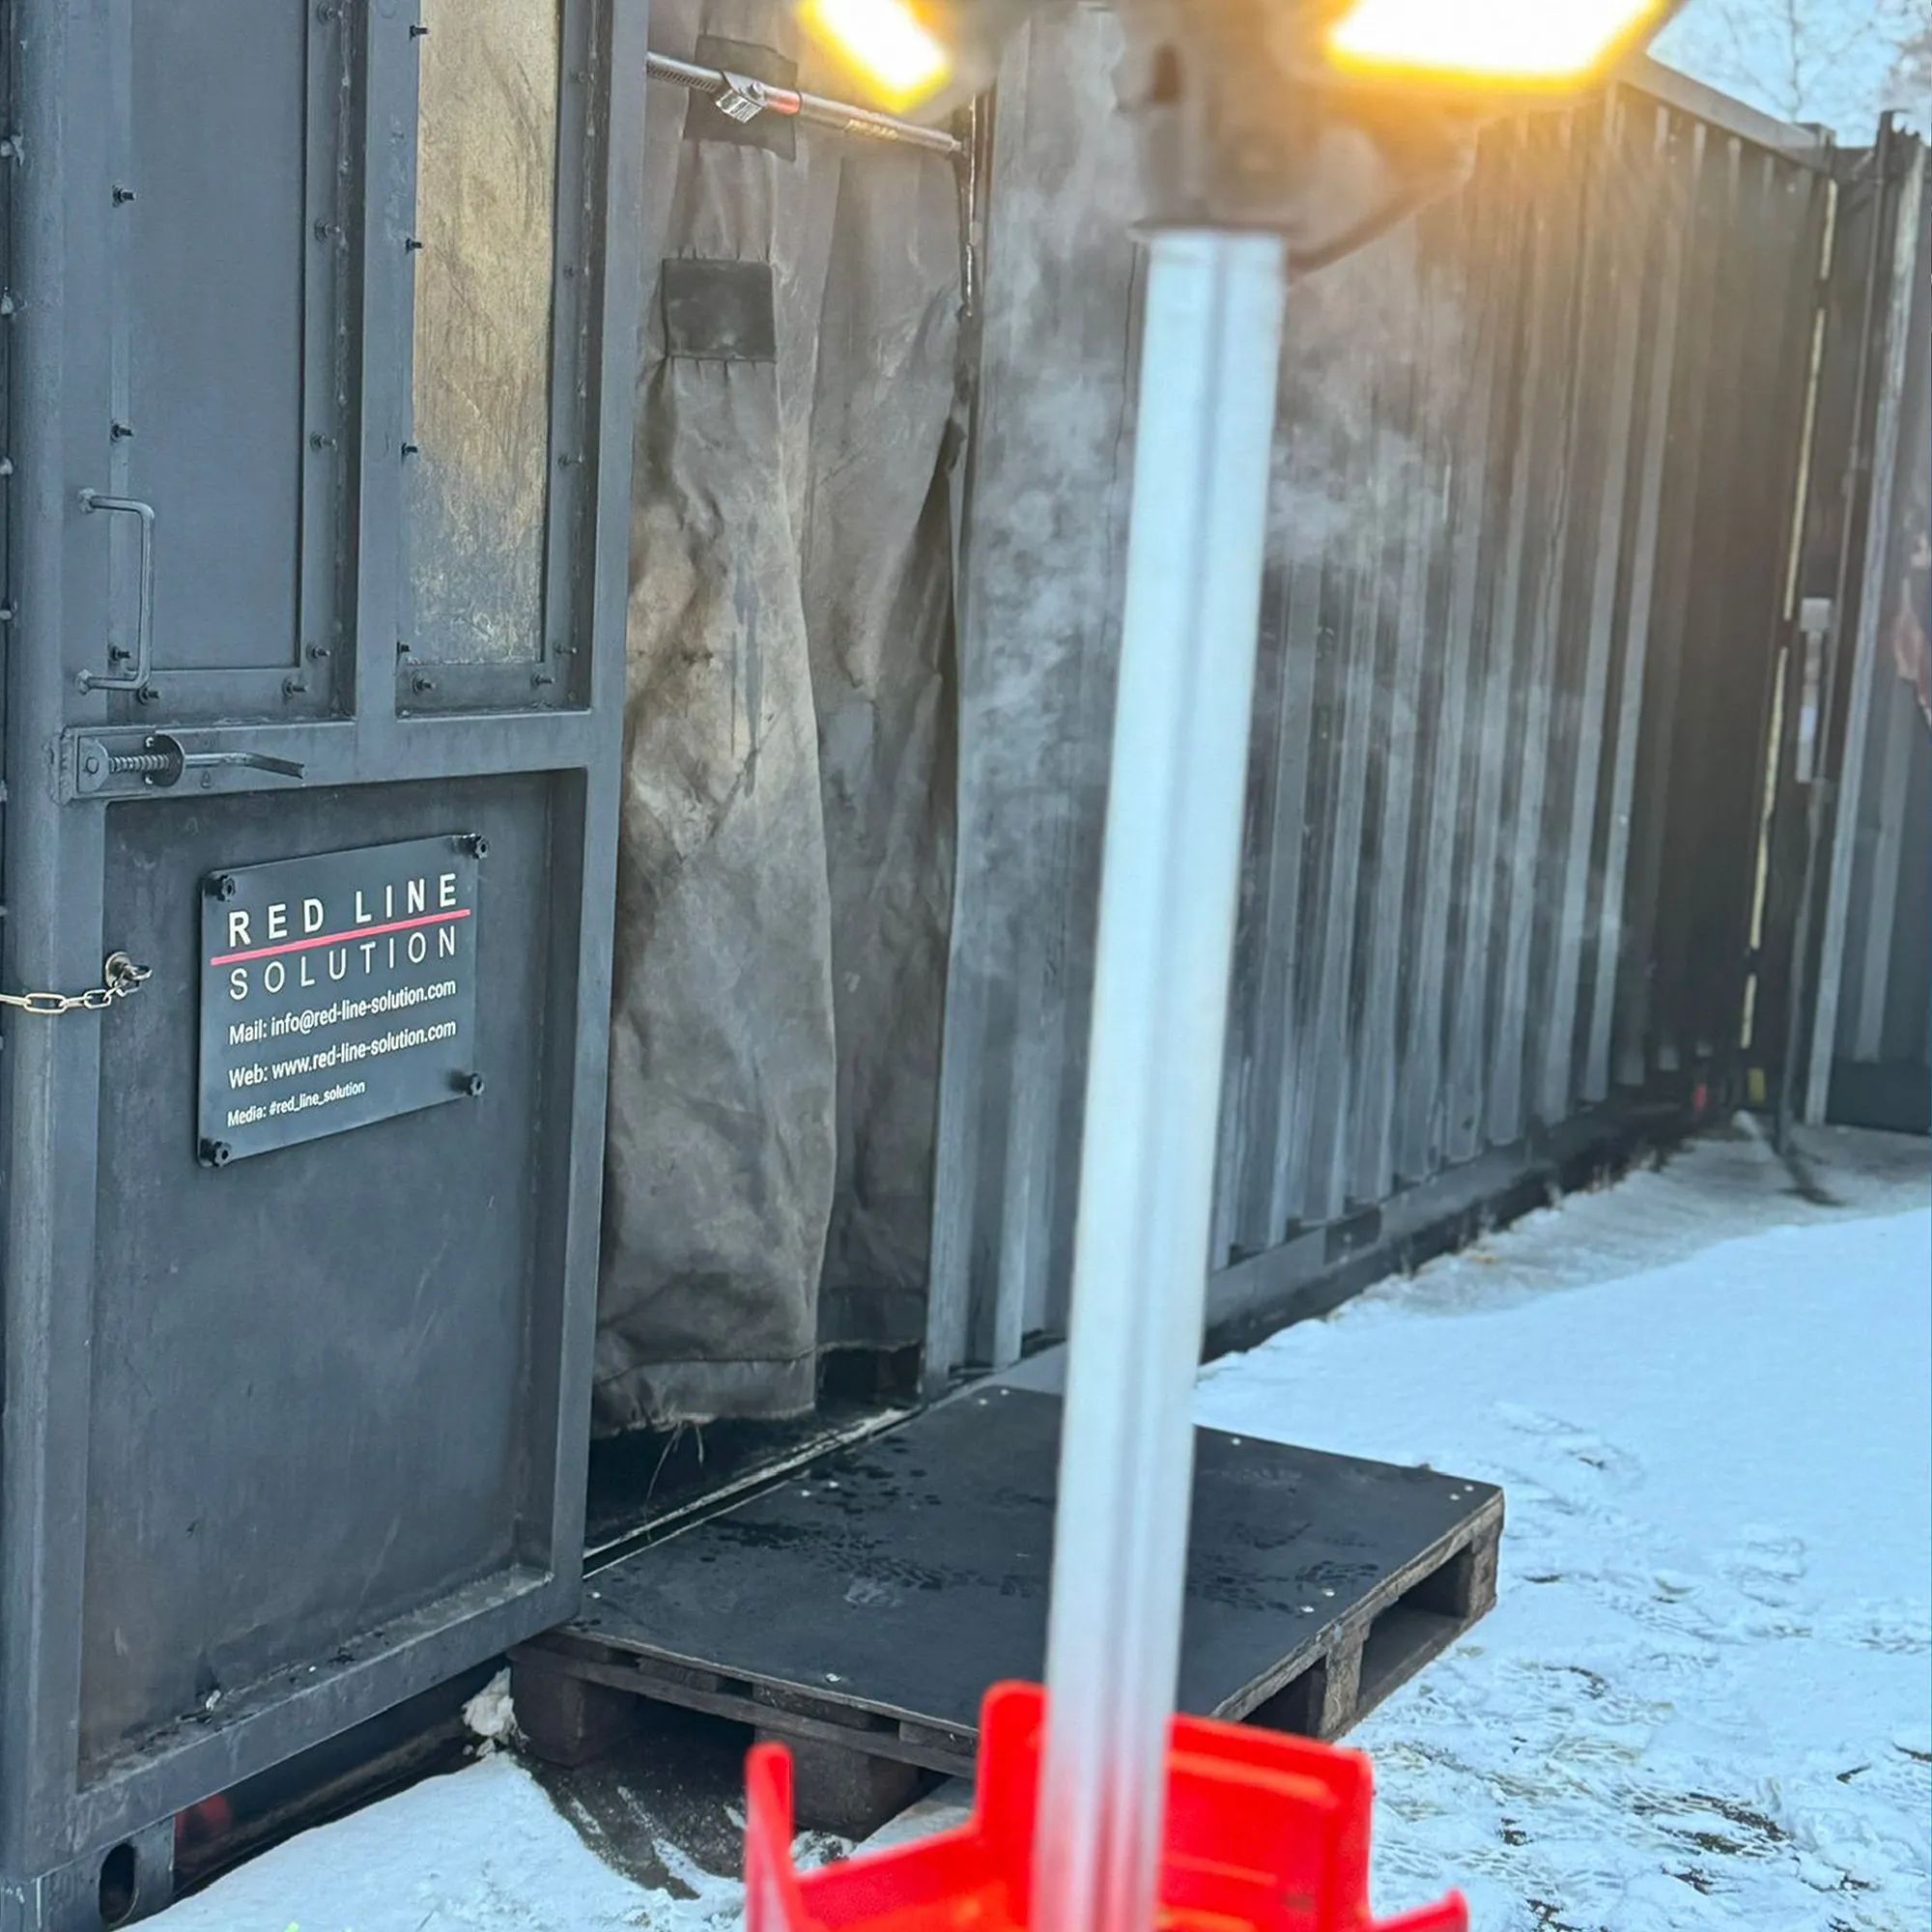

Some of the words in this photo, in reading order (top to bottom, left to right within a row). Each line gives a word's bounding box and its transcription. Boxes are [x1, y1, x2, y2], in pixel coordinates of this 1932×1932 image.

[228, 898, 324, 948] RED
[355, 872, 457, 923] LINE
[229, 925, 456, 1001] SOLUTION
[229, 1019, 268, 1045] Mail:
[270, 980, 456, 1037] info@red-line-solution.com
[228, 1064, 269, 1089] Web:
[271, 1019, 456, 1080] www.red-line-solution.com
[227, 1105, 267, 1128] Media:
[269, 1080, 366, 1117] #red_line_solution
